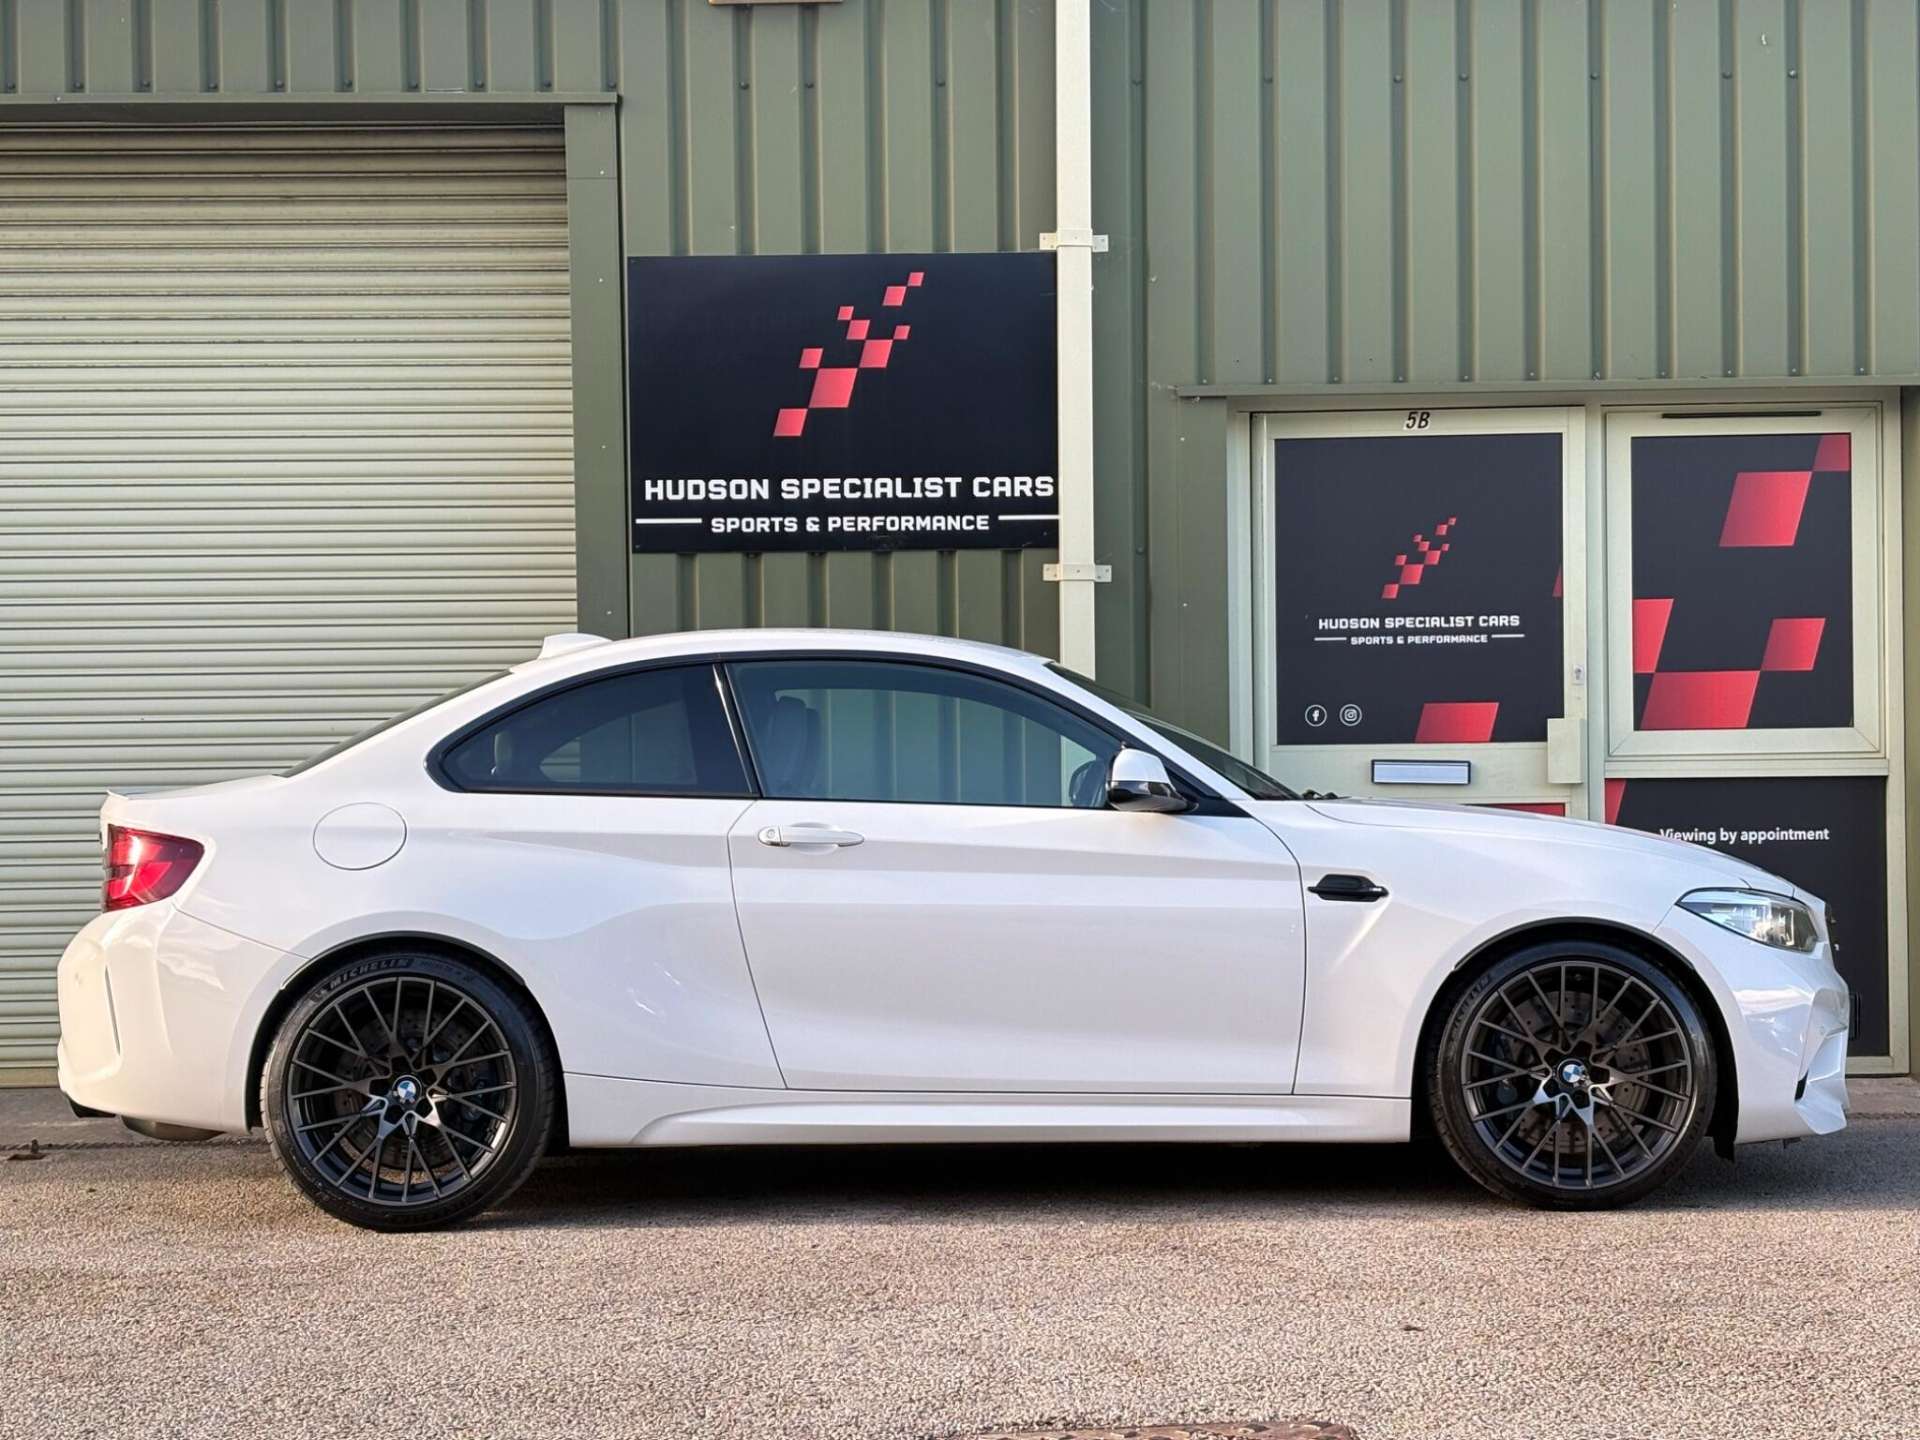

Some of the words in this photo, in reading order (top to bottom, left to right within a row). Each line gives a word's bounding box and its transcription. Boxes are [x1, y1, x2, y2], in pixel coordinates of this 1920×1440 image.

[1406, 411, 1430, 429] 5B
[644, 478, 770, 501] HUDSON
[780, 476, 963, 500] SPECIALIST
[972, 475, 1054, 498] CARS
[711, 516, 798, 533] SPORTS
[805, 516, 820, 532] &
[827, 514, 990, 532] PERFORMANCE
[1318, 616, 1380, 630] HUDSON
[1384, 615, 1475, 629] SPECIALIST
[1478, 613, 1521, 627] CARS
[1350, 635, 1394, 646] SPORTS
[1407, 634, 1488, 645] PERFORMANCE
[1659, 827, 1716, 845] Viewing
[1719, 827, 1738, 845] by
[1740, 826, 1830, 845] appointment
